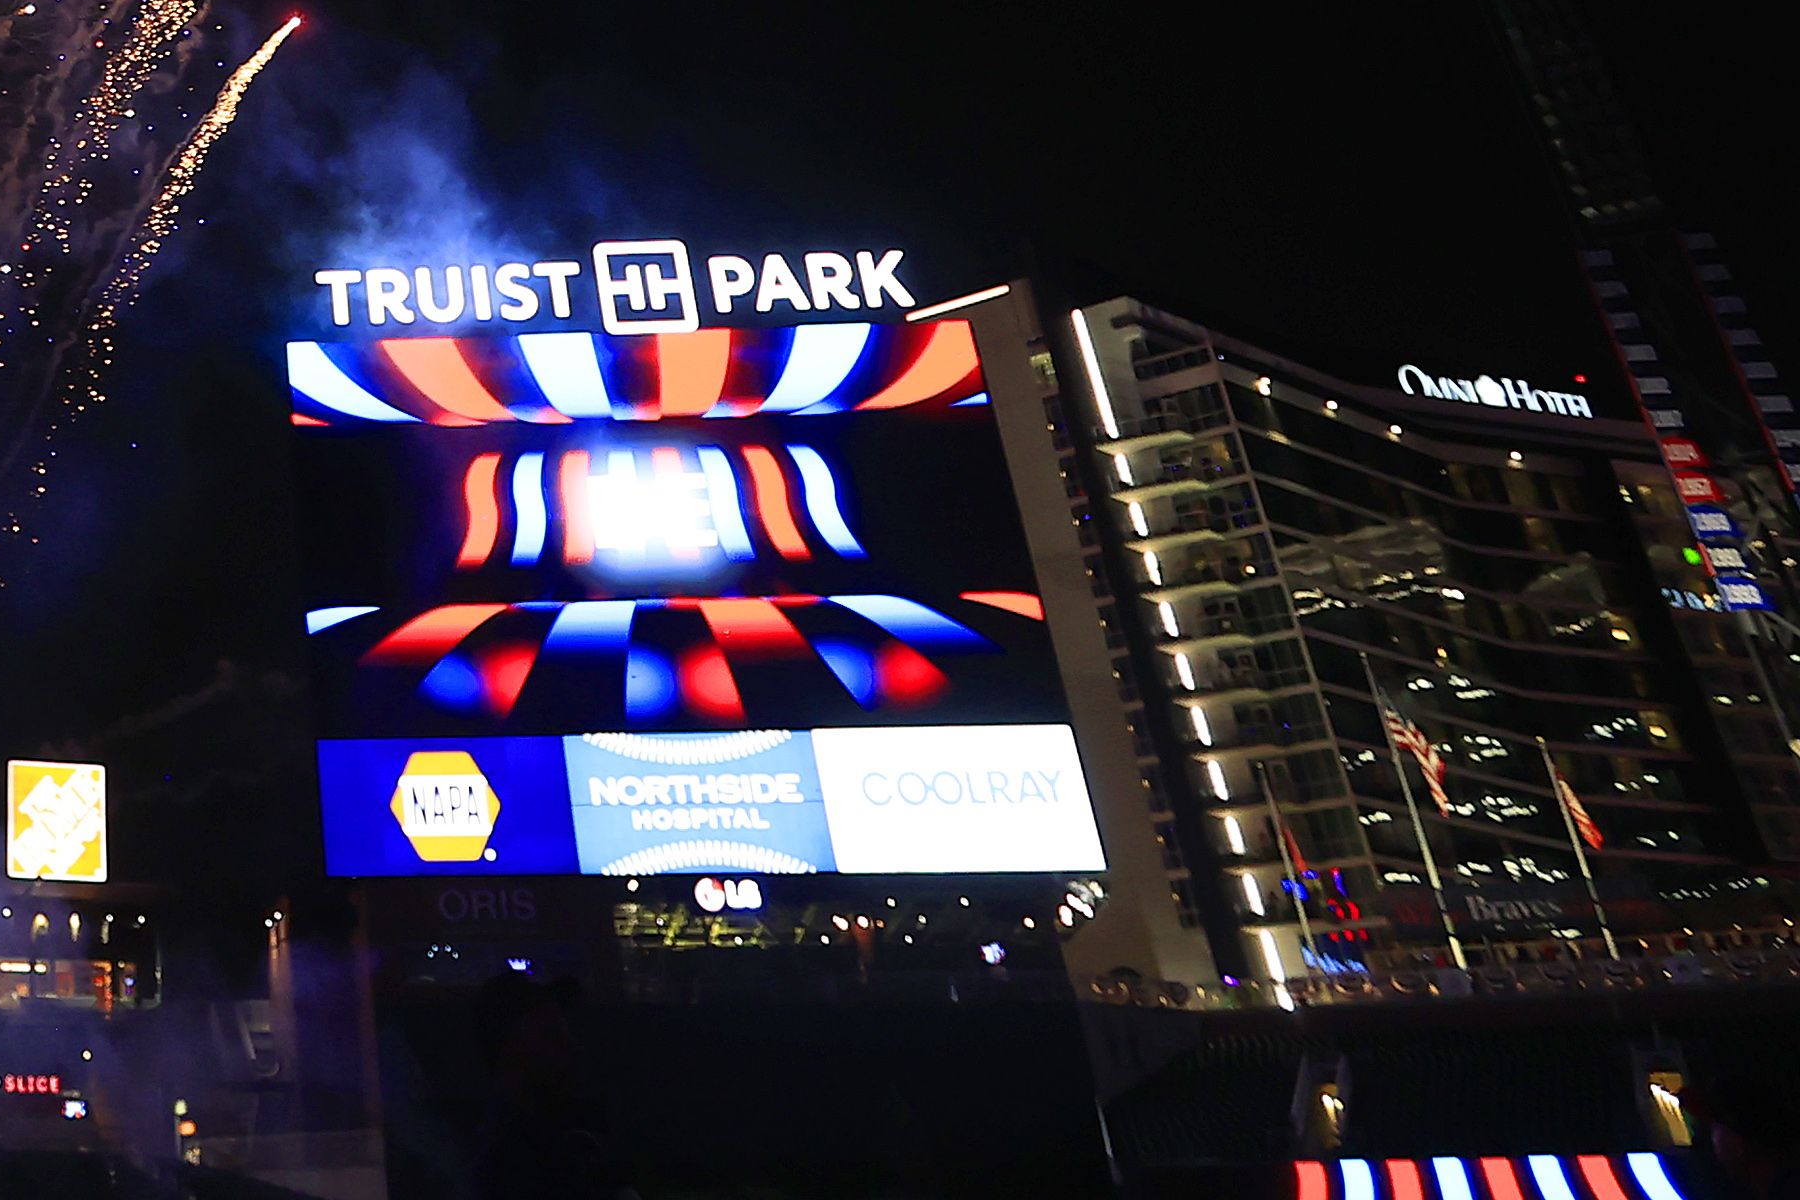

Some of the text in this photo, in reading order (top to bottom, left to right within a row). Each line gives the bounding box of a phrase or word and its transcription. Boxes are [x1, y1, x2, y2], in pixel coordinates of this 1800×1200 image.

[315, 250, 915, 325] TRUIST PARK
[588, 773, 804, 807] NORTHSIDE
[862, 770, 1061, 806] COOLRAY
[411, 786, 482, 826] NAPA
[631, 807, 770, 832] HOSPITAL
[438, 887, 537, 922] ORIS
[723, 879, 763, 910] LG
[4, 1073, 61, 1094] SLICE
